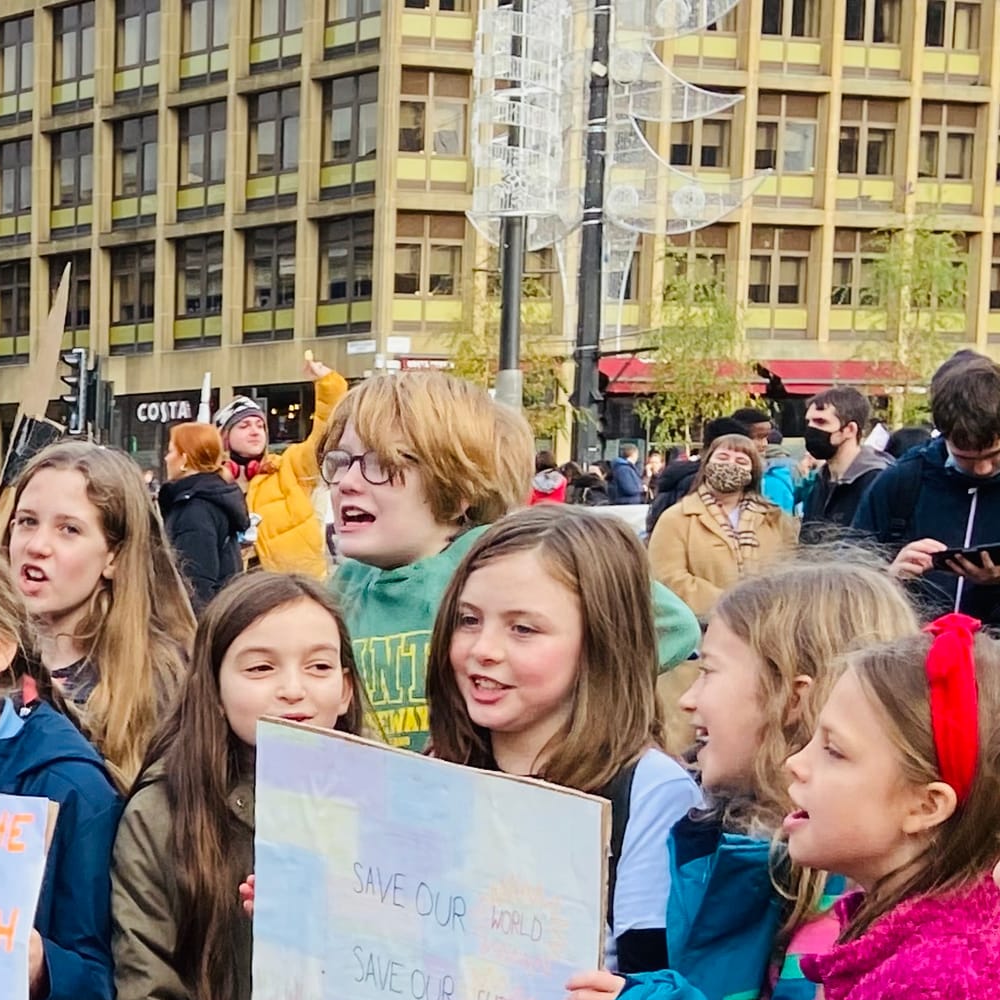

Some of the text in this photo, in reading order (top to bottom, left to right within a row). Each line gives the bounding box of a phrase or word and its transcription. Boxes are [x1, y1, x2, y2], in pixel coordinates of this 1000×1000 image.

[137, 400, 192, 423] COSTA
[353, 862, 544, 943] SAVE OUR WORLD
[352, 945, 405, 994] SAVE
